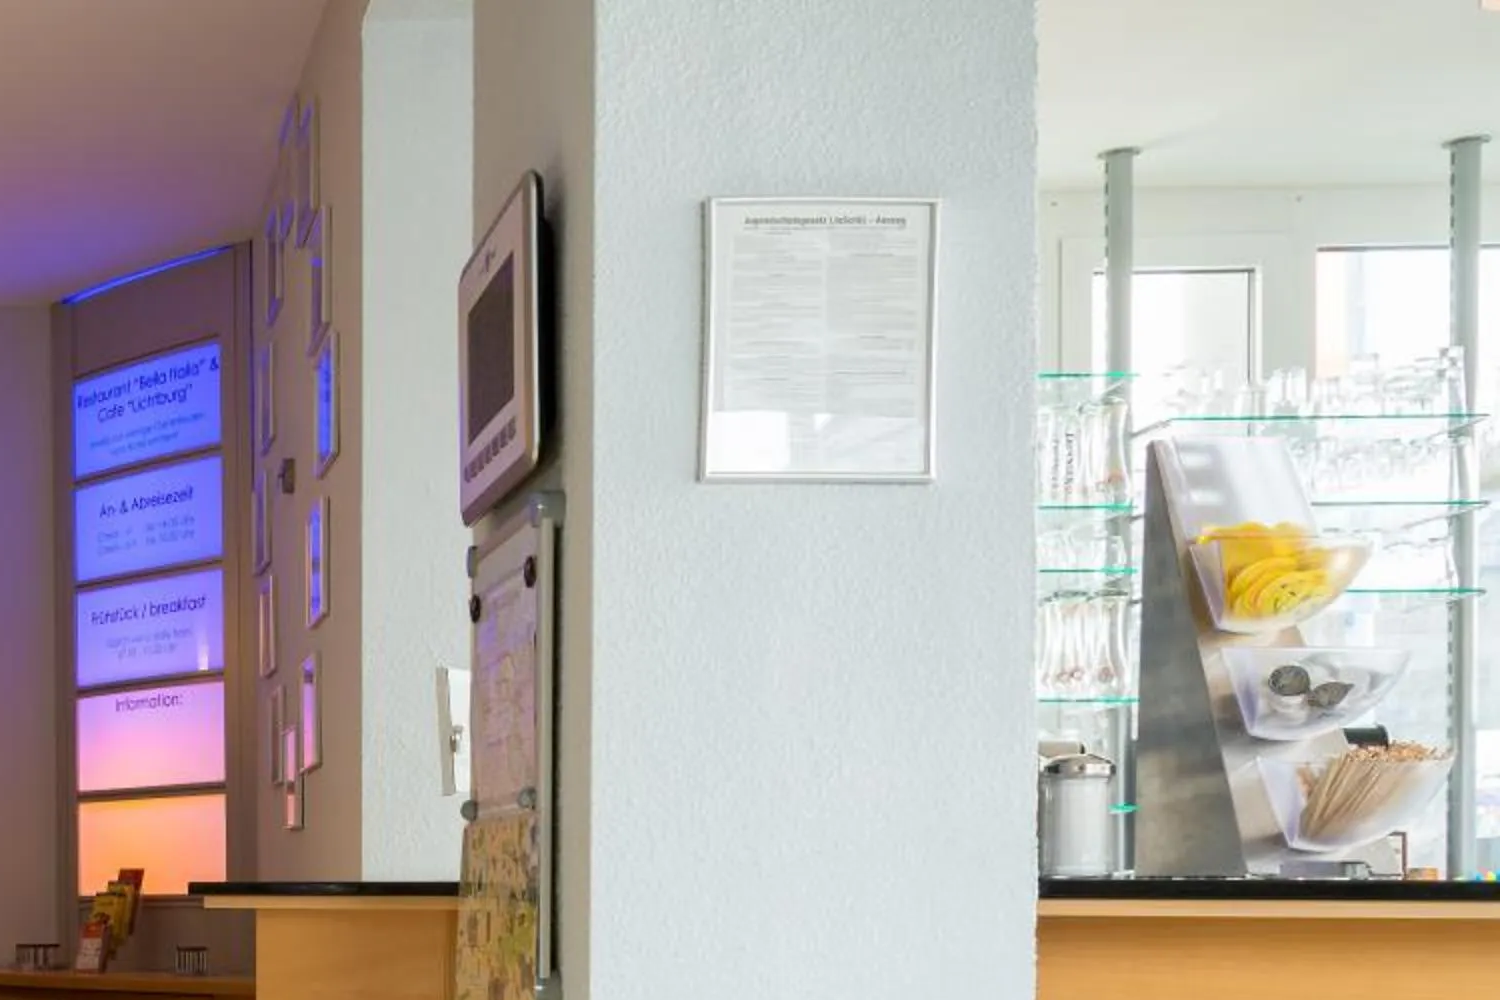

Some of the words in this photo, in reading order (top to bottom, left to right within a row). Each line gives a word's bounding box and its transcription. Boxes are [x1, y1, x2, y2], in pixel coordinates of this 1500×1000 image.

[77, 379, 131, 409] Restaurant
[209, 355, 219, 372] &
[119, 500, 128, 514] &
[150, 595, 207, 616] breakfast
